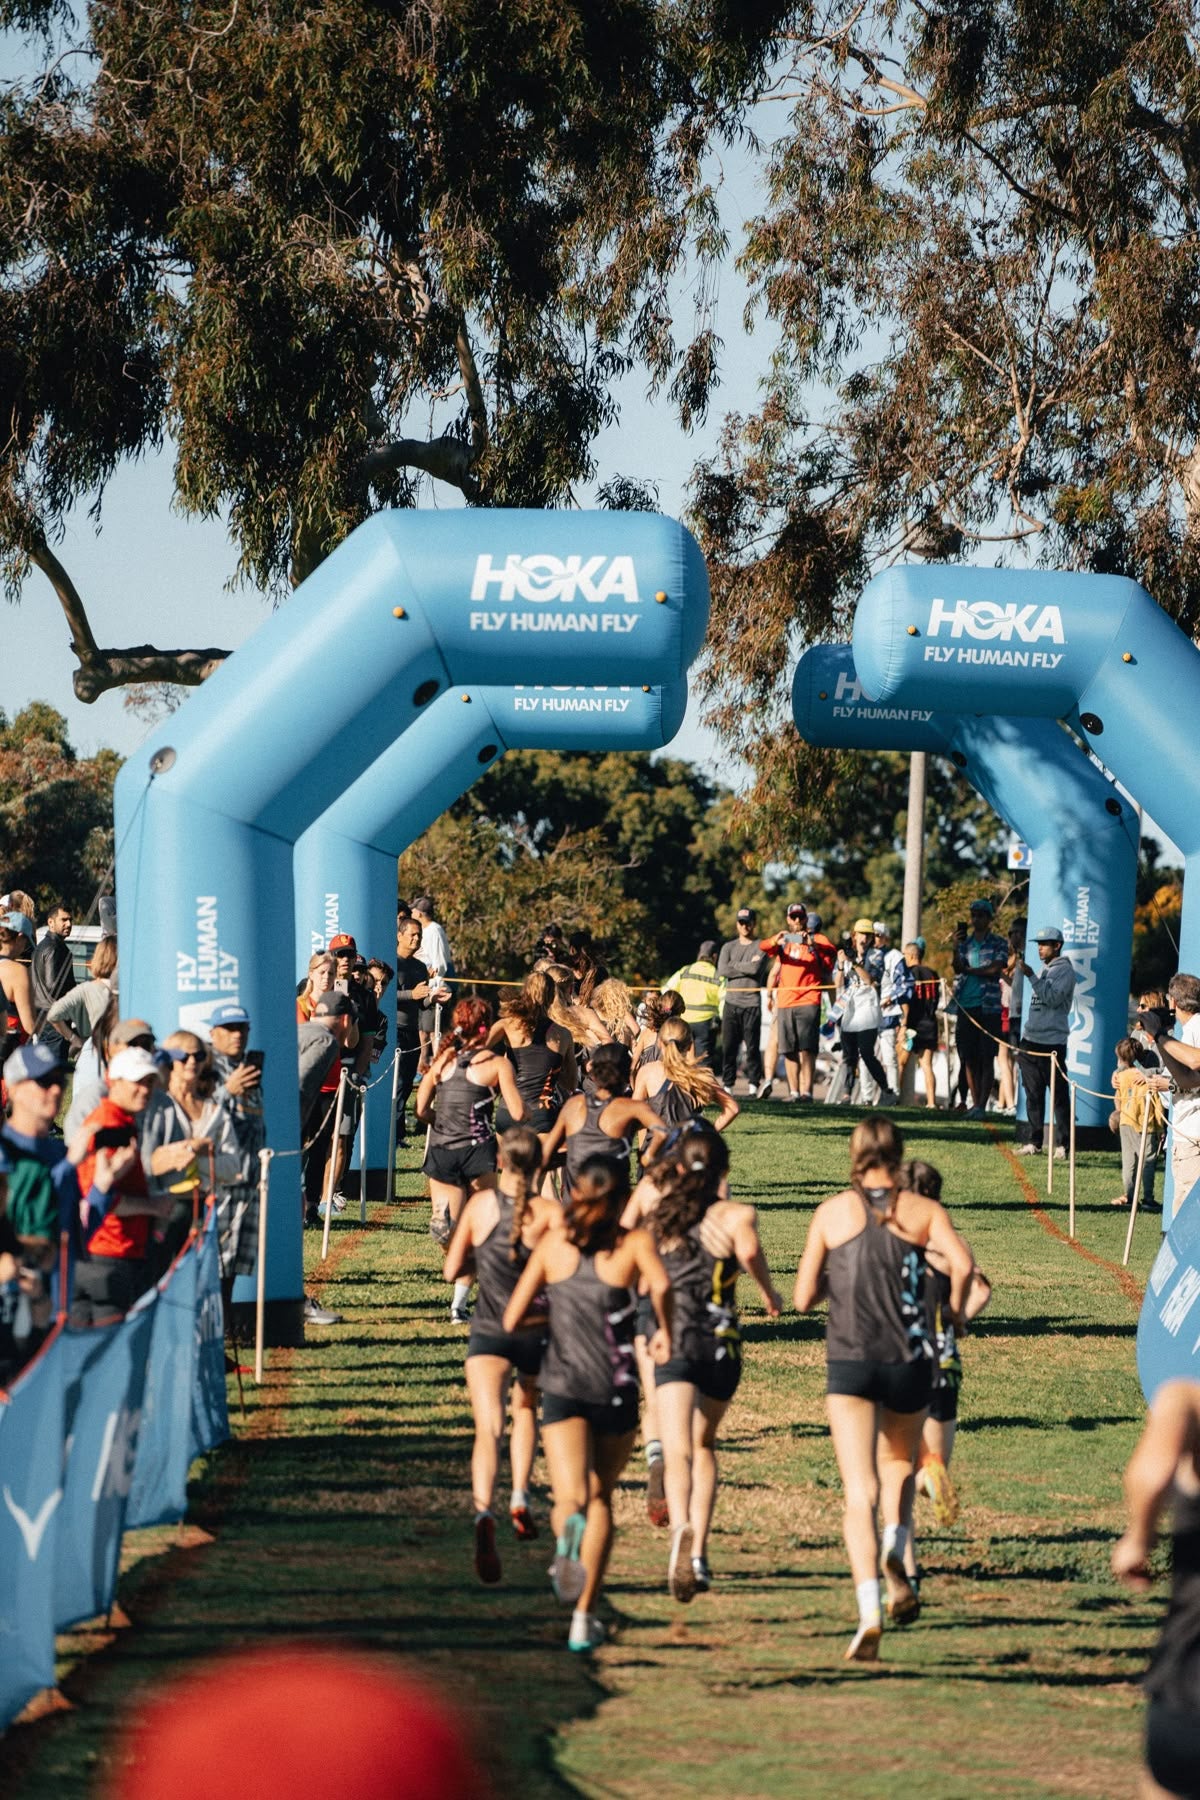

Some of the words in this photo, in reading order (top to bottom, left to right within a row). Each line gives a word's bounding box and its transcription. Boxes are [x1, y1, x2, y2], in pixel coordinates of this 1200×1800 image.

[470, 554, 640, 603] HOKA
[470, 612, 507, 631] FLY
[511, 612, 598, 632] HUMAN
[602, 614, 639, 633] FLY
[926, 598, 1065, 645] HOKA
[924, 646, 954, 662] FLY
[957, 647, 1029, 667] HUMAN
[1031, 652, 1063, 669] FLY
[514, 697, 538, 711] FLY
[542, 698, 601, 712] HUMAN
[604, 699, 630, 712] FLY
[833, 706, 854, 718] FLY
[857, 707, 908, 721] HUMAN
[911, 710, 934, 722] FLY
[325, 893, 339, 950] UMAN
[1063, 917, 1075, 942] FLY
[1075, 886, 1090, 943] HUMAN
[1088, 919, 1100, 944] FLY
[196, 896, 218, 991] HUMAN
[177, 951, 197, 992] FLY
[219, 950, 239, 991] FLY
